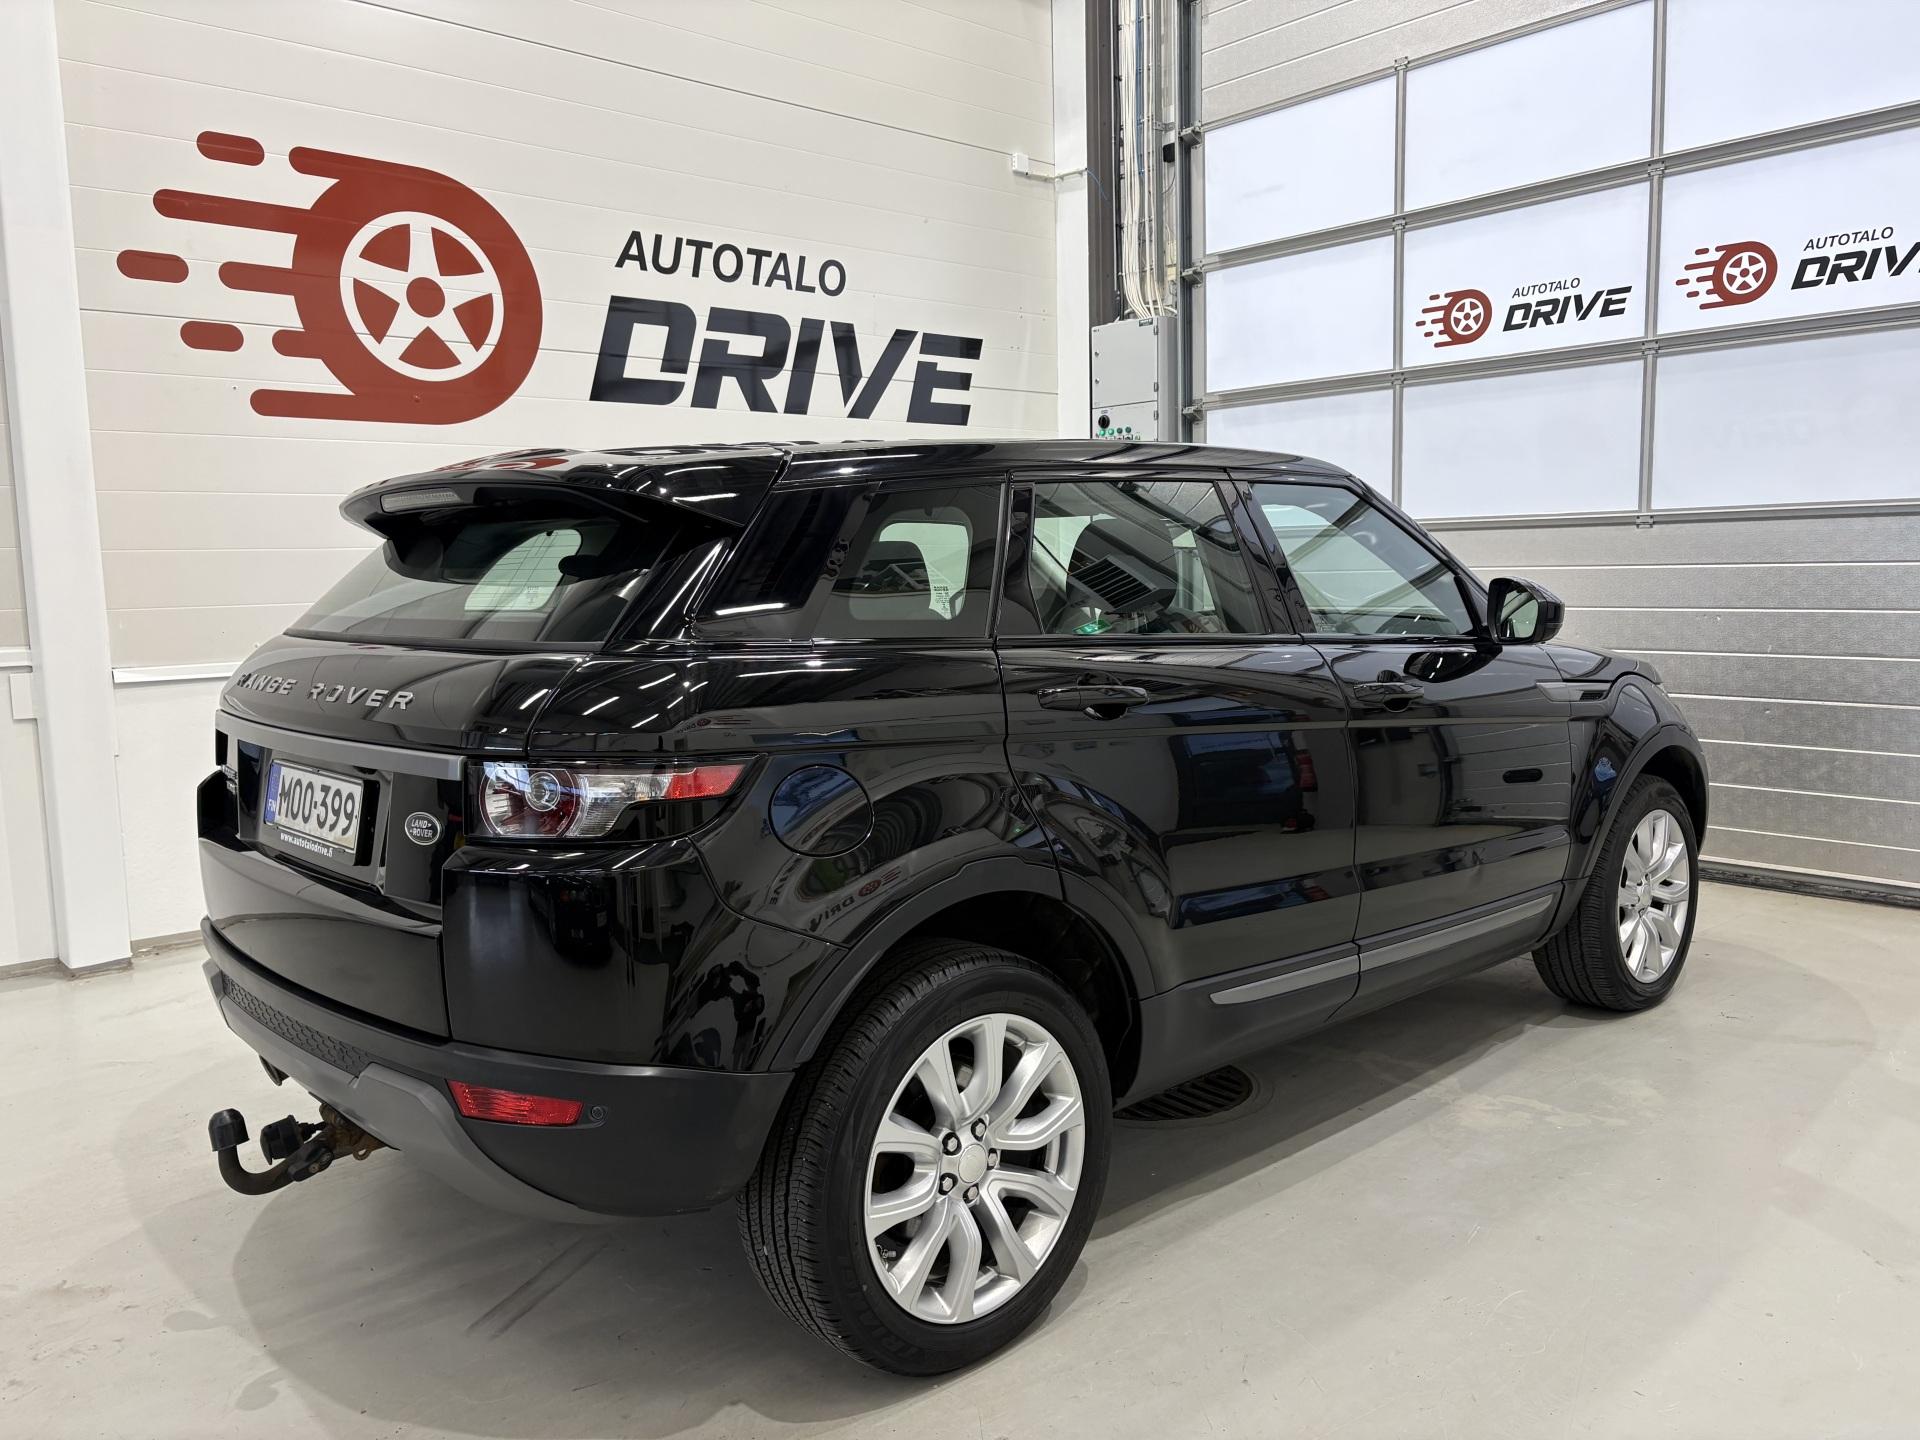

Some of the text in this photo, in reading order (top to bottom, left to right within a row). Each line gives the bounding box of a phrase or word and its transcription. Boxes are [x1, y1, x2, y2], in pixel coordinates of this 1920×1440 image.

[1803, 226, 1894, 252] AUTOTALO
[615, 230, 847, 297] AUTOTALO
[1791, 241, 1920, 290] DRIV
[1502, 285, 1633, 332] DRIVE
[1512, 277, 1581, 299] AUTOTALO
[588, 295, 984, 427] DRIVE
[236, 673, 414, 711] RANGE ROVER
[280, 832, 334, 858] www.autotalodrive.fi
